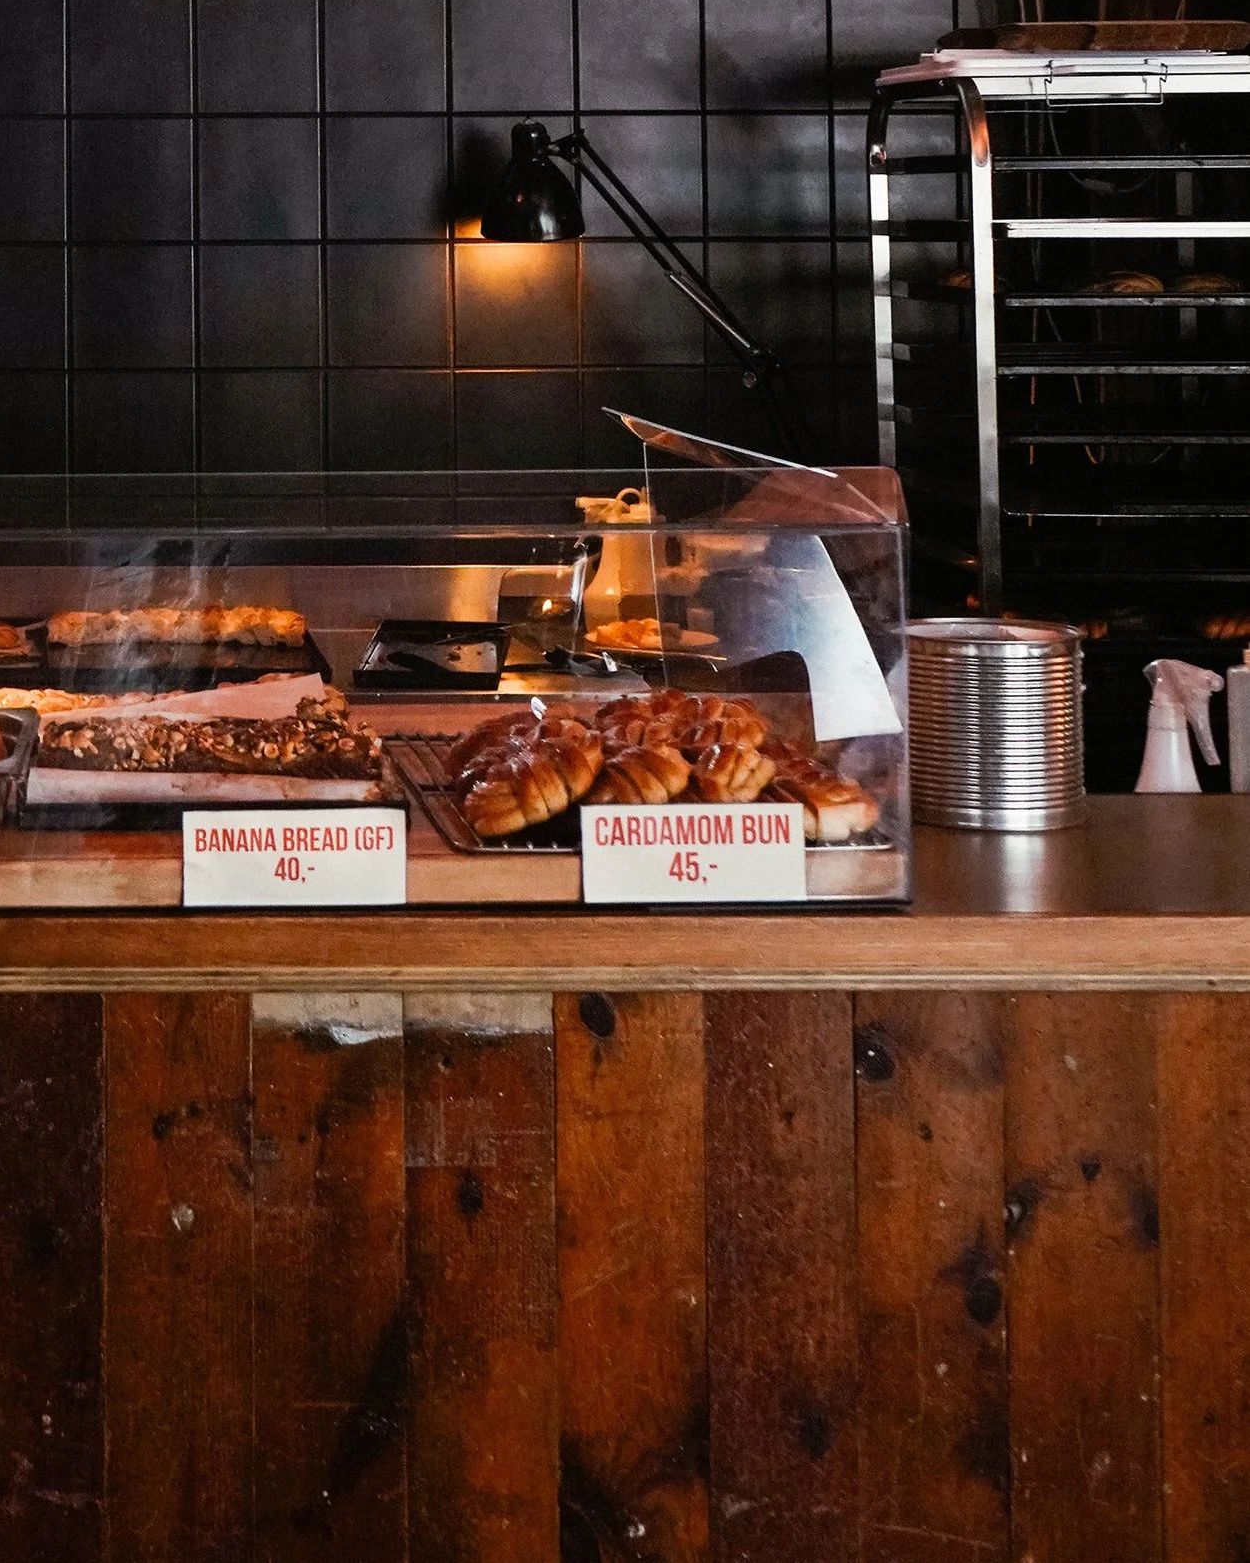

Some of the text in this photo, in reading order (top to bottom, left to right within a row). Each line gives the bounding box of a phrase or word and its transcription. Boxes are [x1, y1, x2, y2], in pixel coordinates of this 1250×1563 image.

[194, 825, 395, 853] BANANA BREAD (GF)
[594, 813, 791, 847] CARDAMOM BUN
[273, 856, 316, 886] 40,-
[669, 851, 718, 884] 45,-
